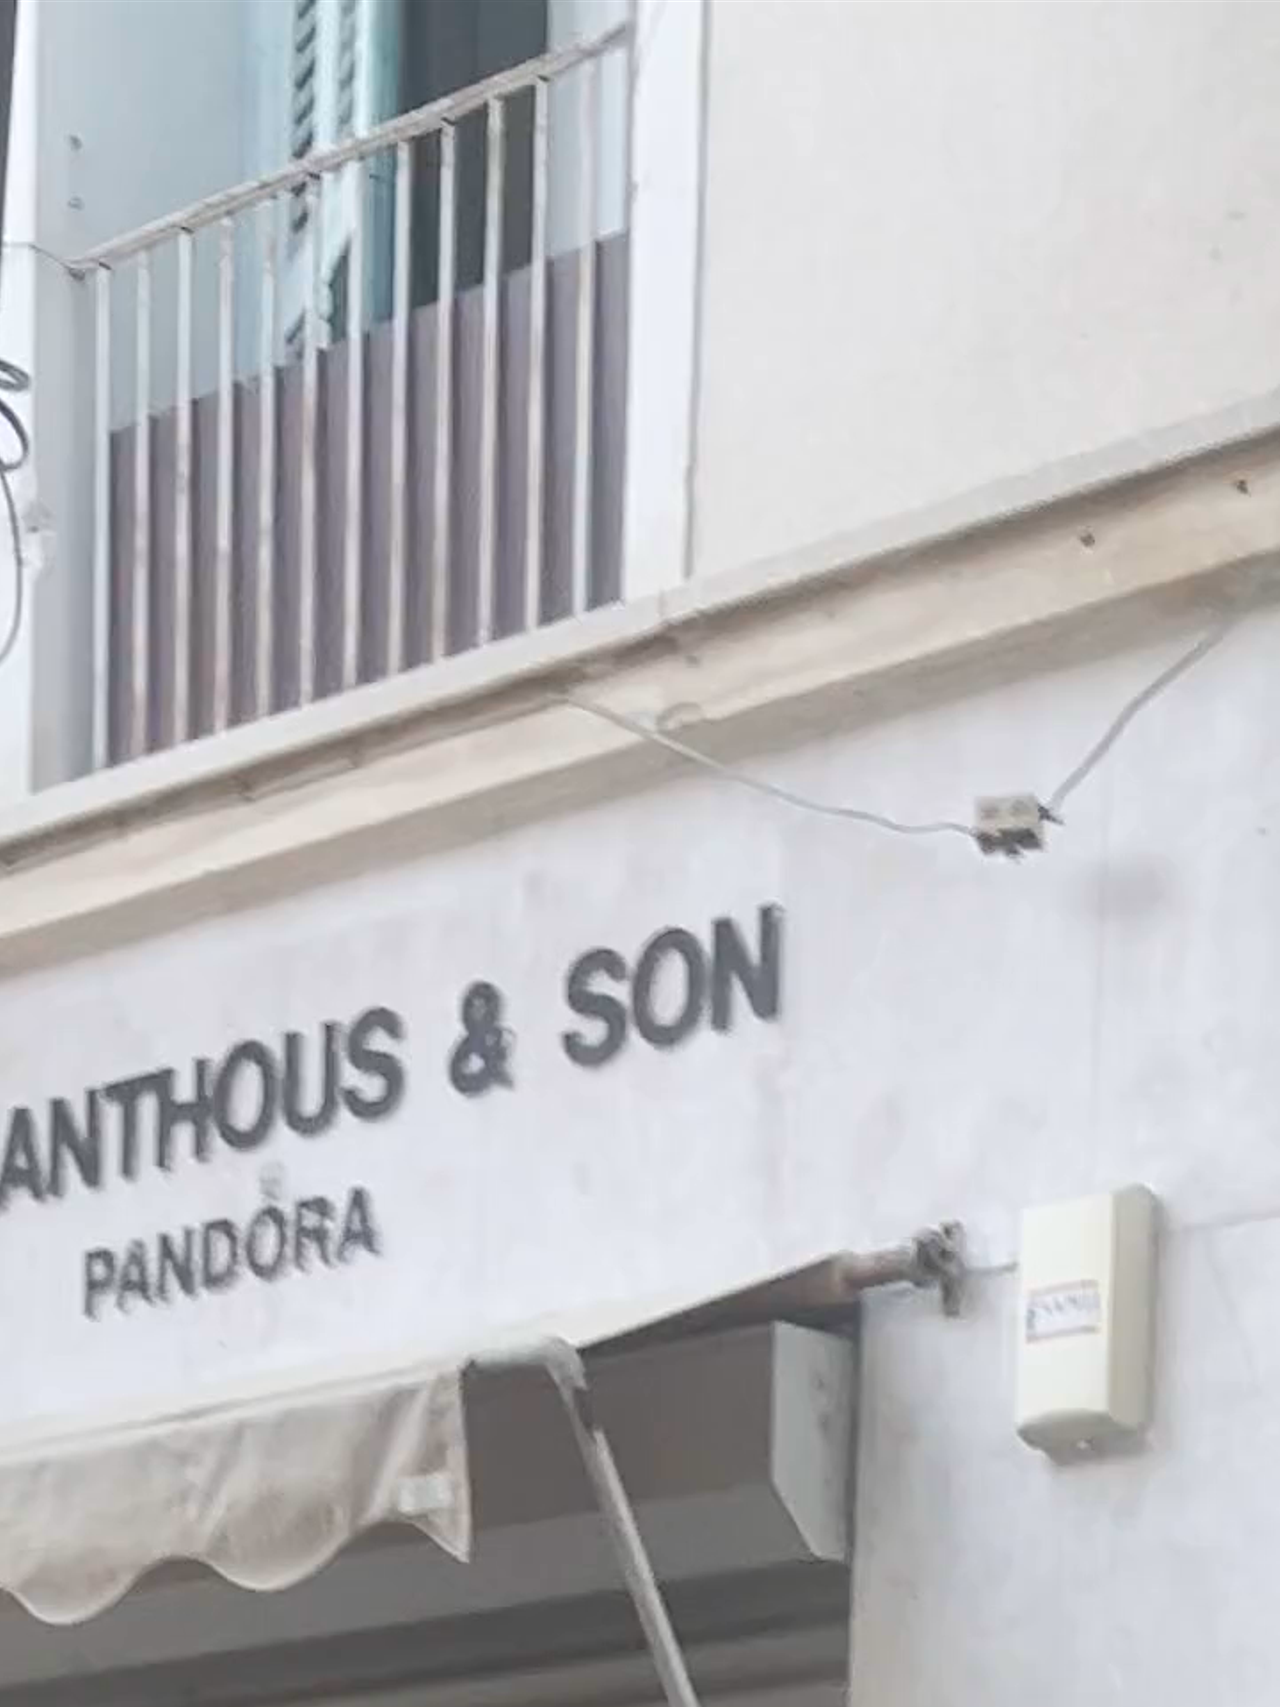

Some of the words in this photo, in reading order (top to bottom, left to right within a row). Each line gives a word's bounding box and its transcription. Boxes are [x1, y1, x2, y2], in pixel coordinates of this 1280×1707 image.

[448, 980, 516, 1098] &
[560, 902, 784, 1068] SON
[83, 1185, 382, 1322] PANDORA
